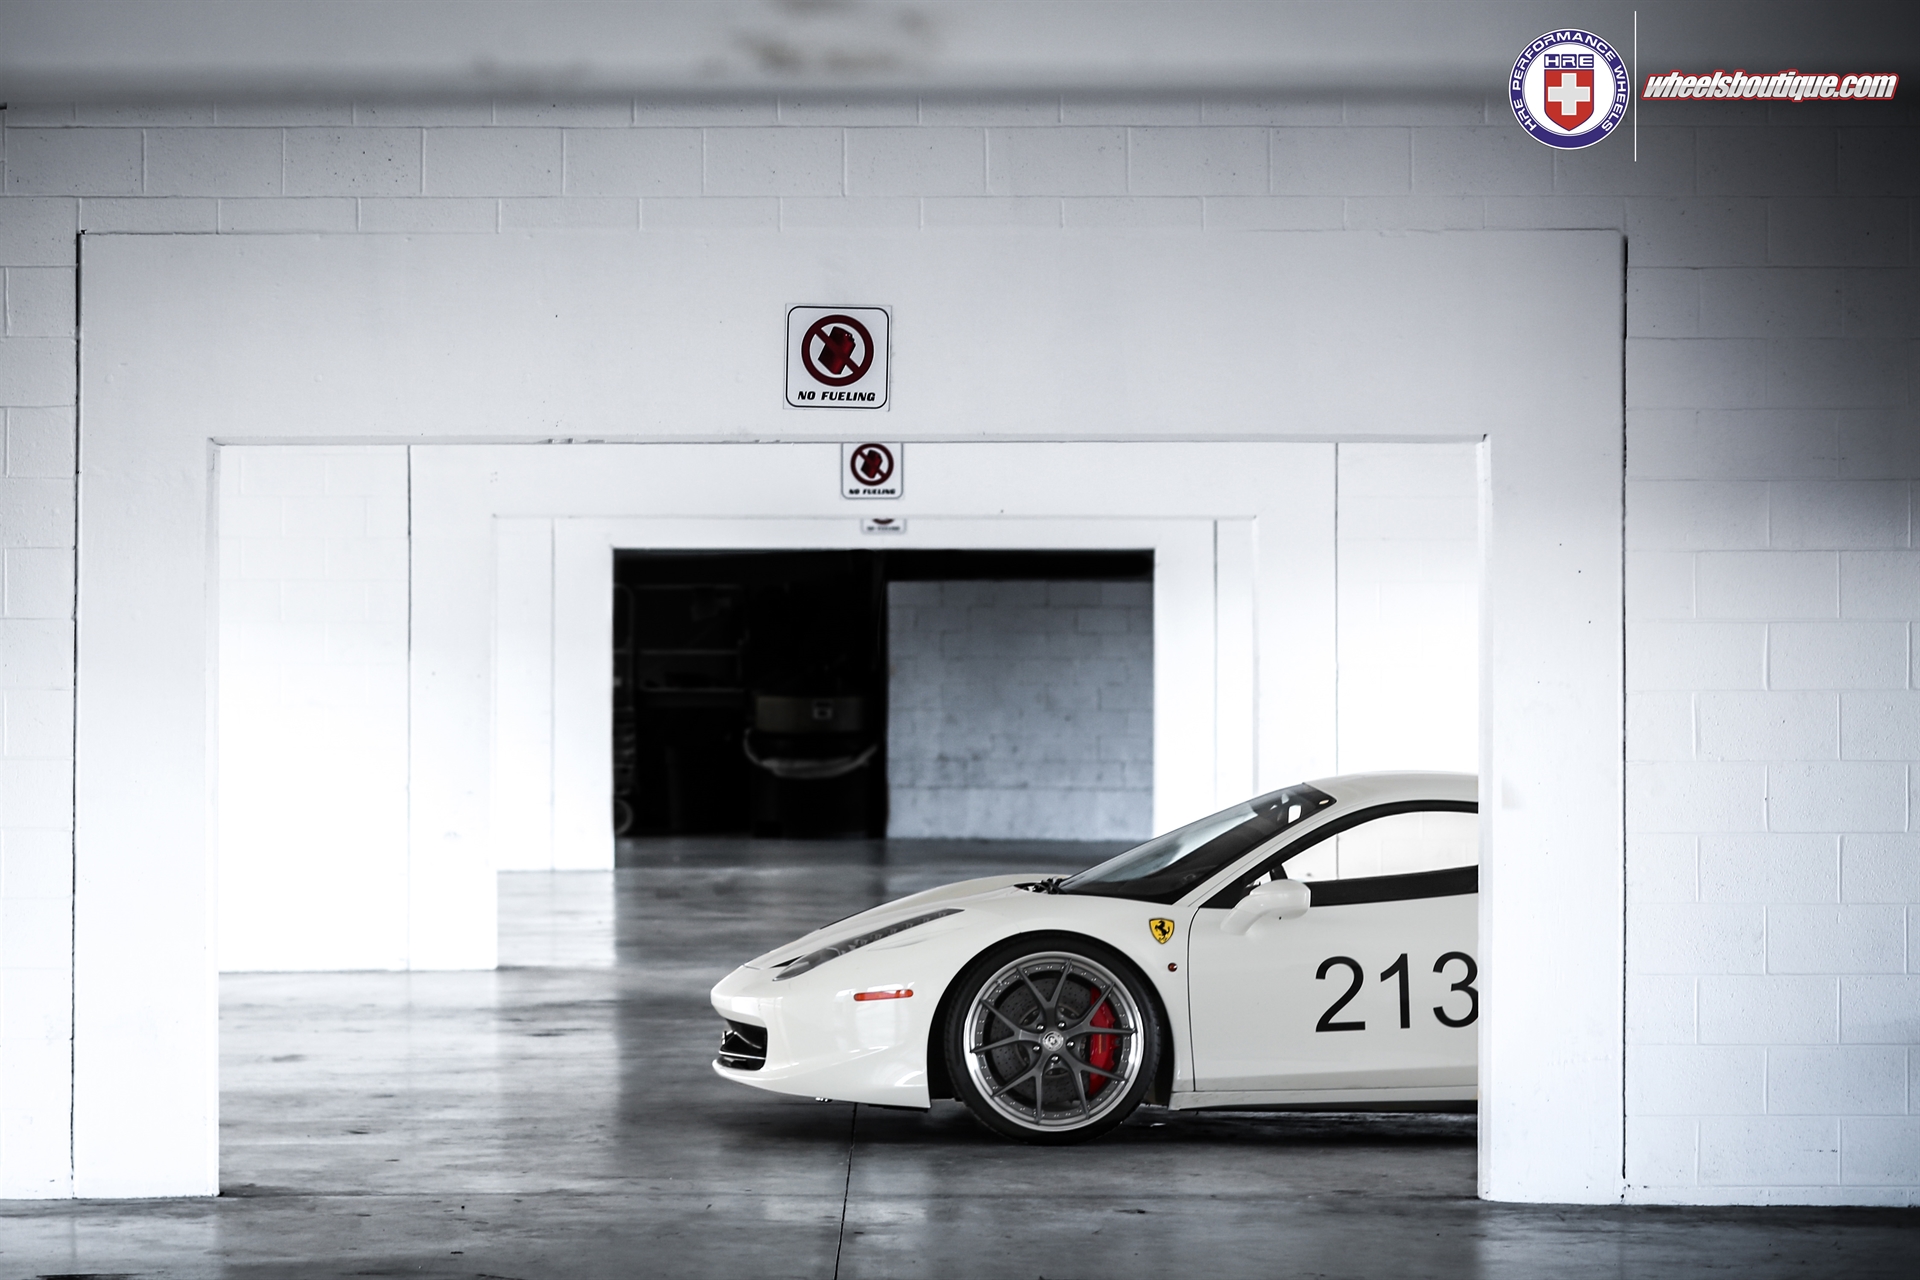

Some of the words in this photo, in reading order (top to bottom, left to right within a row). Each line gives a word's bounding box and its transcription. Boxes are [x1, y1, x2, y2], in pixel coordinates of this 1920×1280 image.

[797, 391, 815, 400] NO
[820, 391, 876, 402] FUELING
[1315, 951, 1479, 1033] 213
